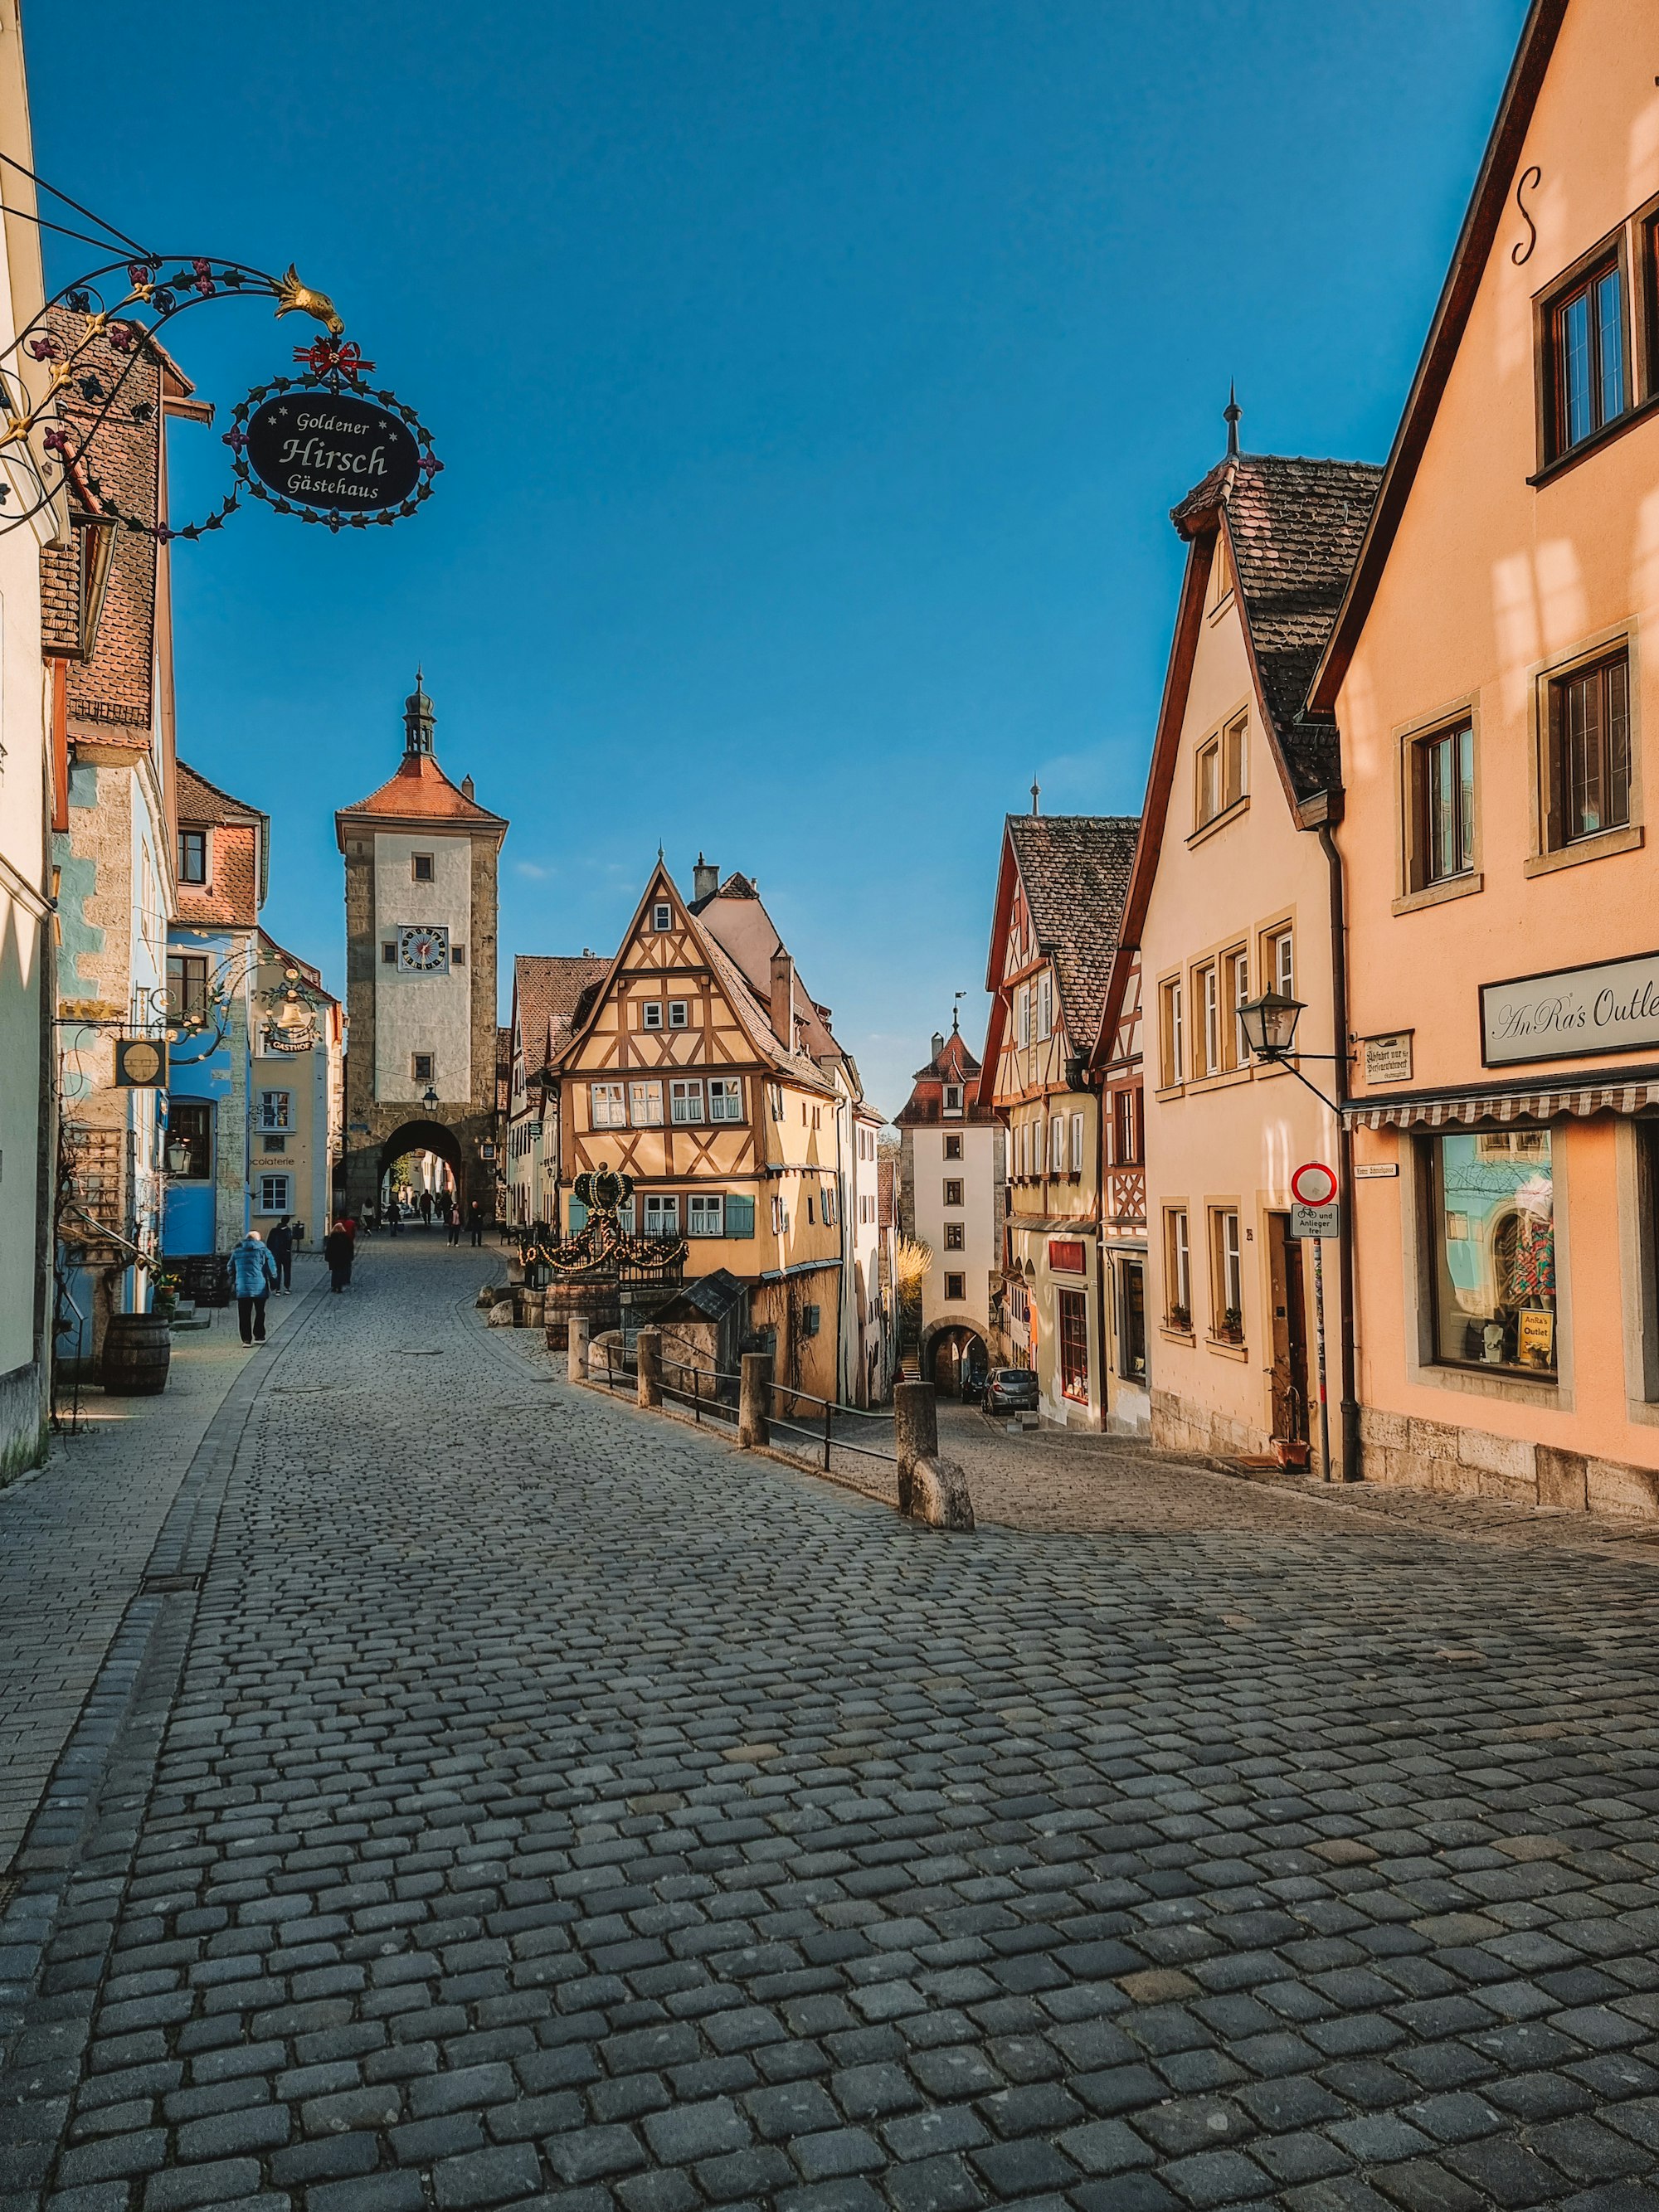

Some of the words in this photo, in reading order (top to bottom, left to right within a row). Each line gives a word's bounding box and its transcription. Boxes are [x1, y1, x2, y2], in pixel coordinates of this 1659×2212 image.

[296, 413, 370, 435] Goldener
[279, 437, 388, 475] Hirsch
[287, 474, 379, 498] Gästehaus
[273, 1041, 310, 1052] GASTHOF
[1524, 1327, 1549, 1336] Outlet
